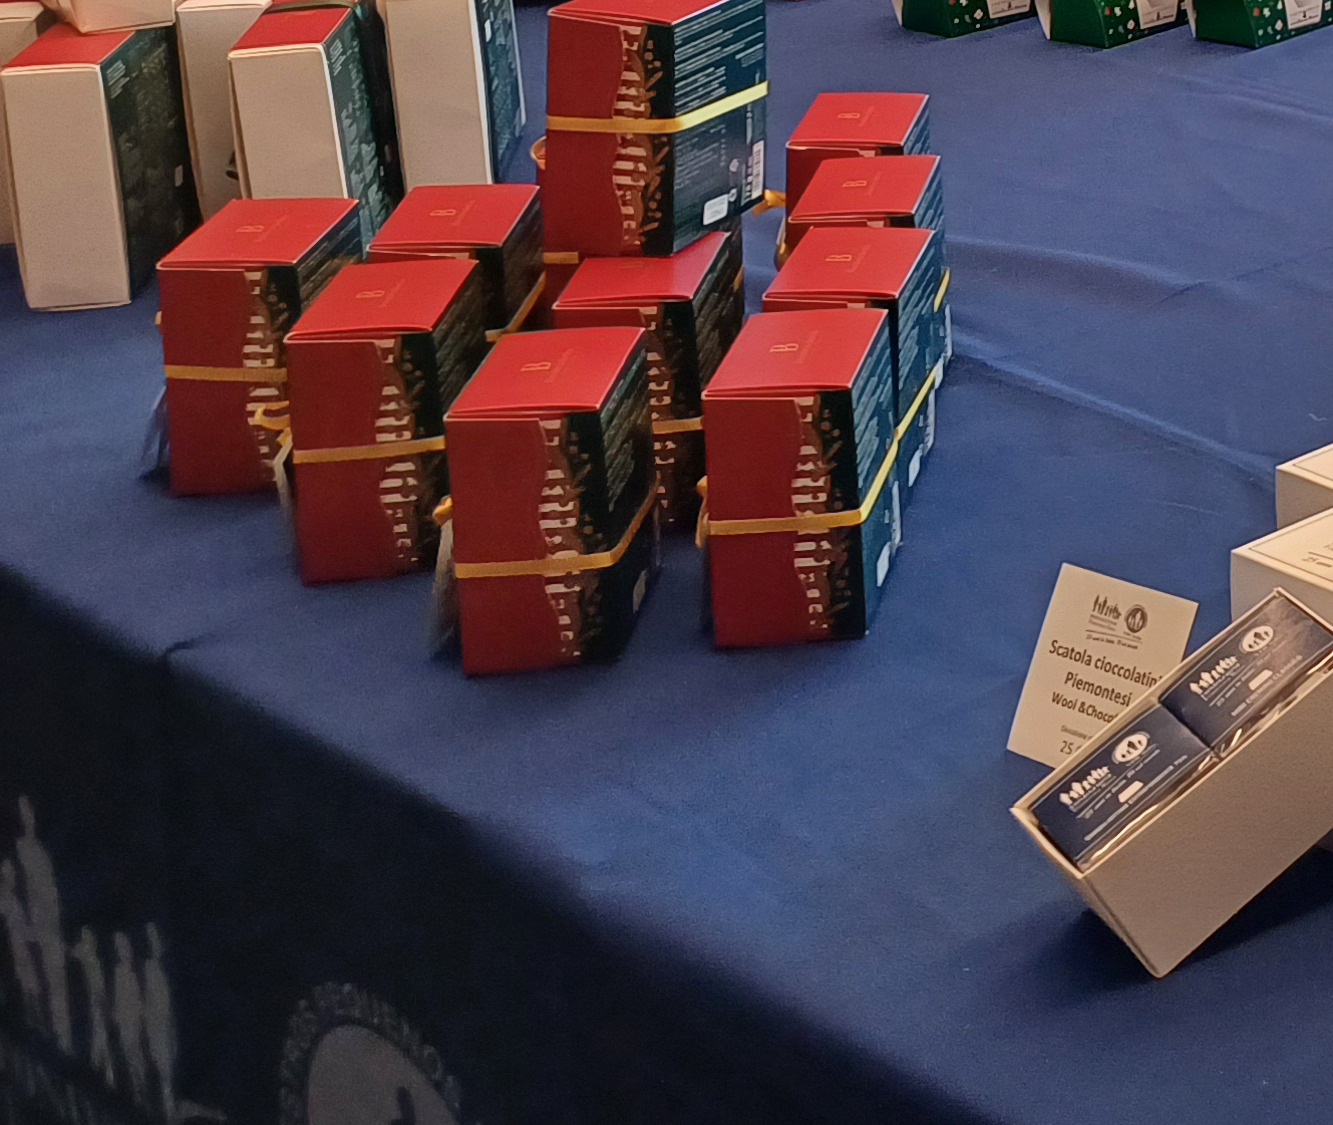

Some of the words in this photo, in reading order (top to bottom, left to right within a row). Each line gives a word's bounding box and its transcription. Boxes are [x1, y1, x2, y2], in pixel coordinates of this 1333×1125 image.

[1049, 639, 1092, 667] Scatola
[1064, 671, 1134, 707] Piemontesi
[1051, 691, 1077, 711] Wool
[1078, 701, 1120, 724] &Choco
[1059, 740, 1074, 756] 25
